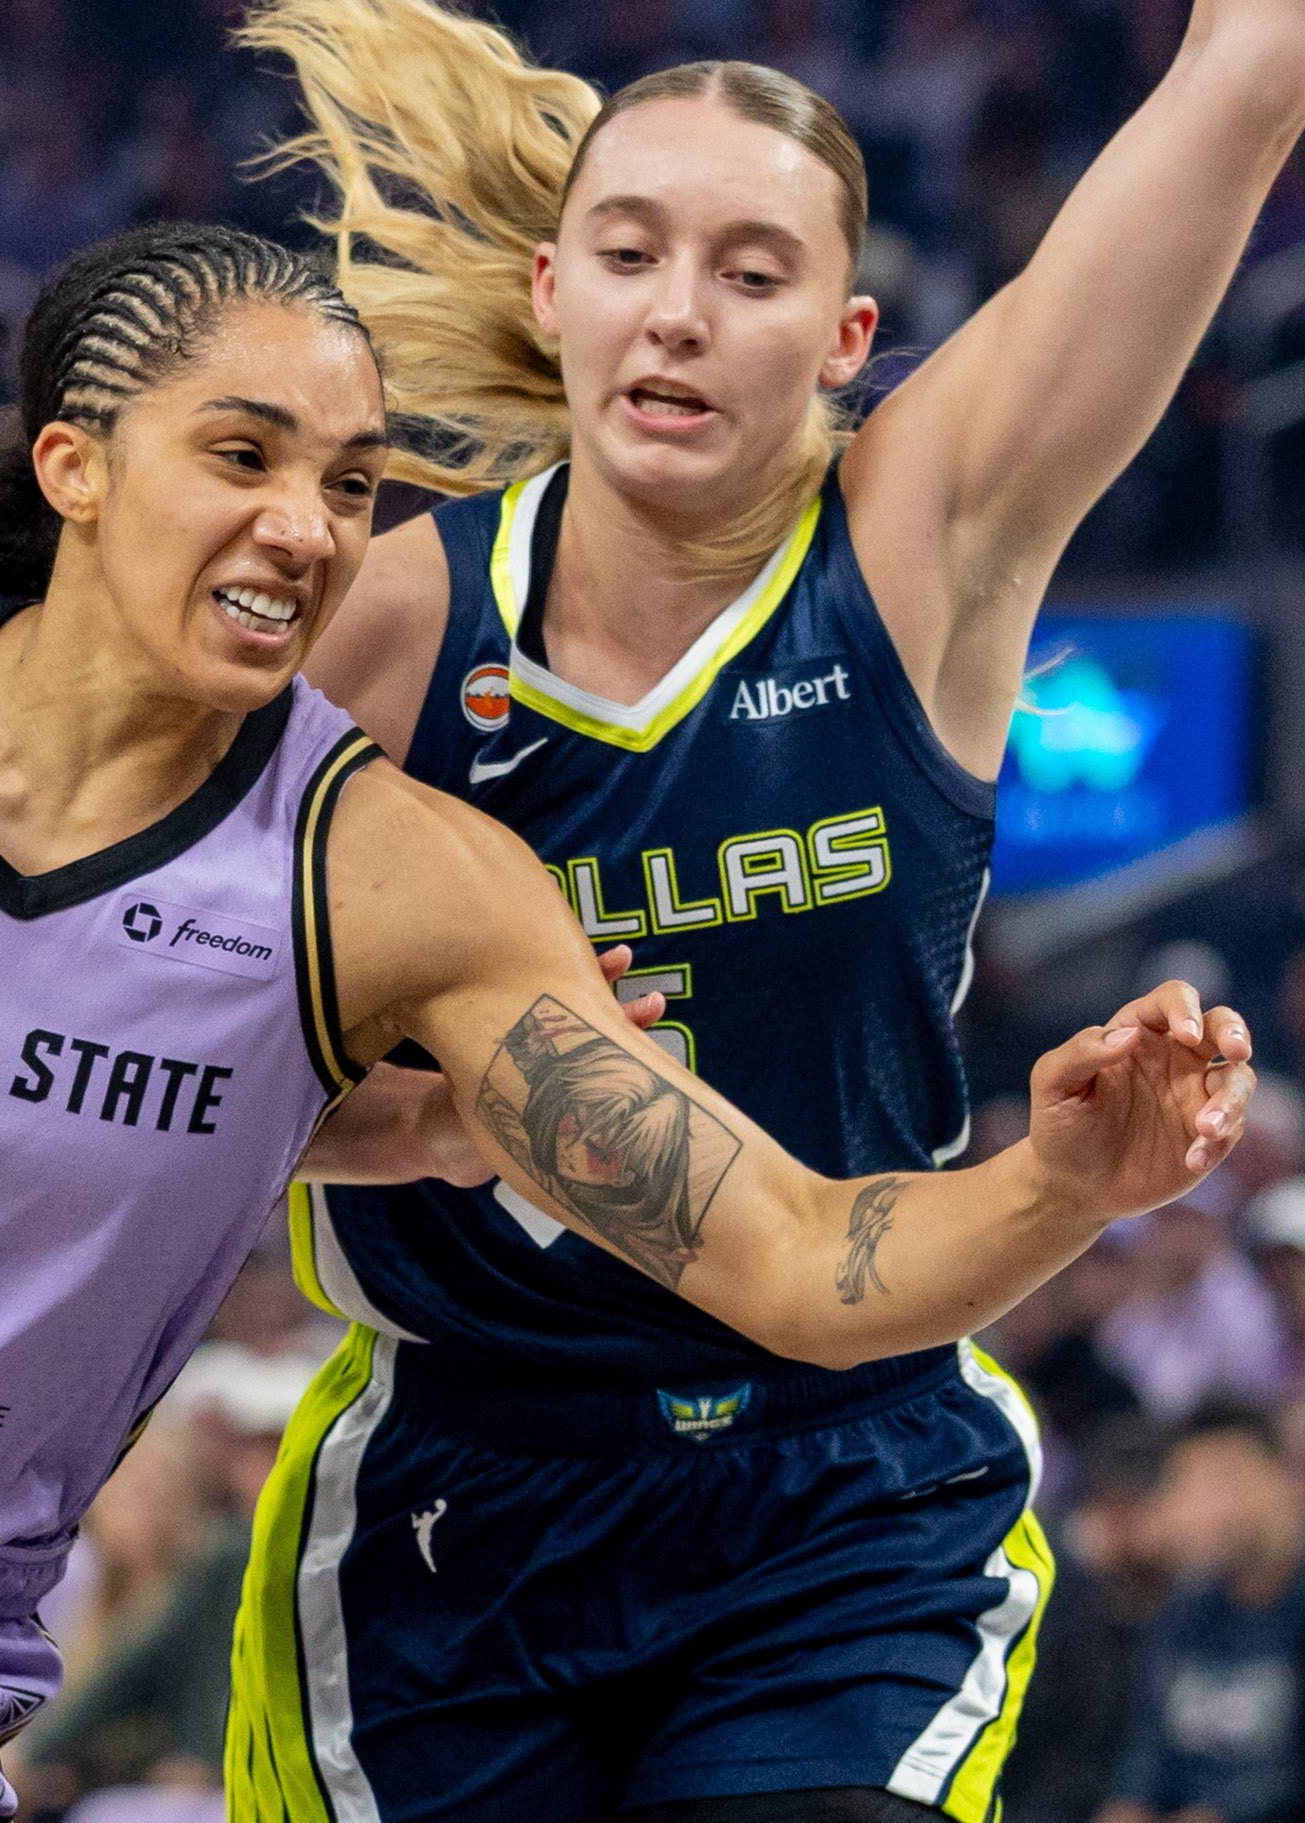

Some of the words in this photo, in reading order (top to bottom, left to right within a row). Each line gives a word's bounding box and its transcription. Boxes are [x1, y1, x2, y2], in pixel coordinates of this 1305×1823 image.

[728, 664, 852, 721] Albert
[545, 806, 892, 943] LLAS
[168, 918, 273, 961] freedom
[8, 1028, 234, 1135] STATE
